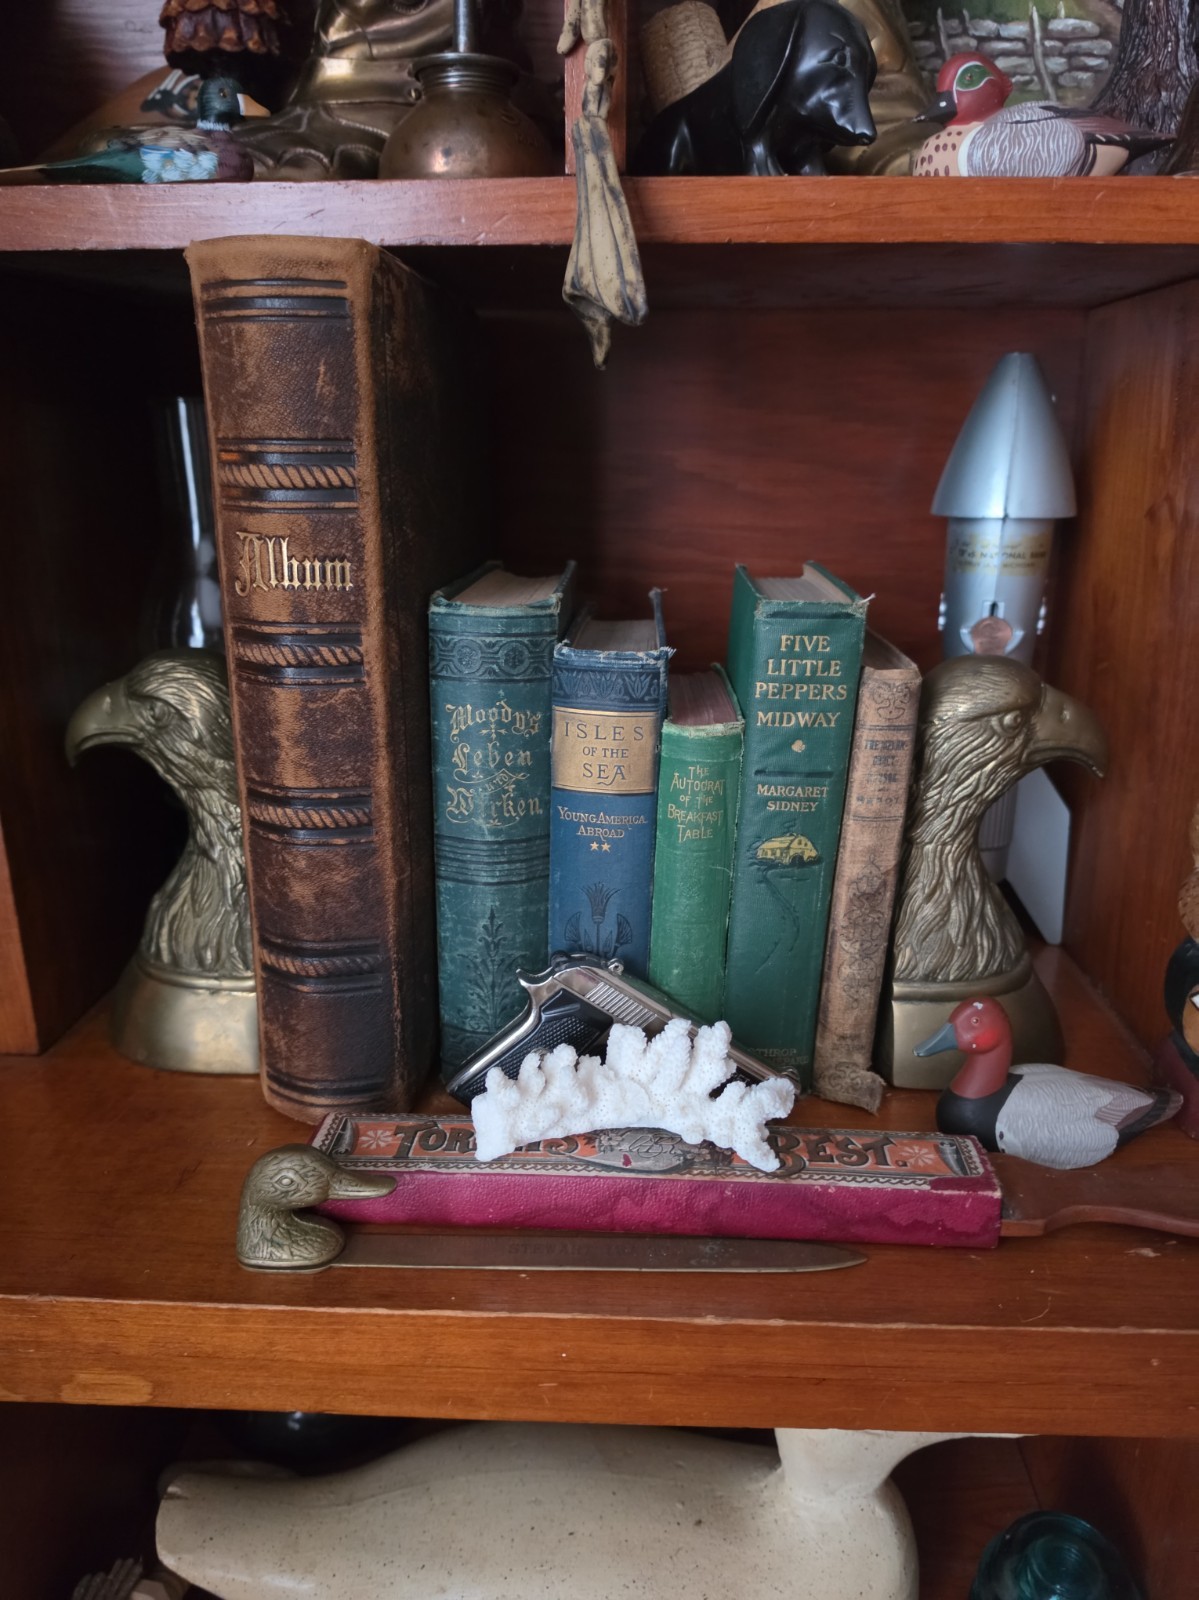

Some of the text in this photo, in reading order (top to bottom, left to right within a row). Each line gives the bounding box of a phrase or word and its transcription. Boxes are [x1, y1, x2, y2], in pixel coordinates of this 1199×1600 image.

[235, 531, 353, 596] Album
[780, 635, 831, 652] FIVE
[767, 658, 842, 677] LITTLE
[755, 682, 847, 700] PEPPERS
[756, 711, 840, 728] MIDWAY
[564, 721, 645, 741] ISLES
[452, 740, 533, 775] Leben
[582, 746, 629, 758] OF THE
[582, 762, 627, 785] SEA
[688, 766, 710, 778] THE
[670, 773, 725, 796] AUTOCRAT
[756, 784, 829, 798] MARGARET
[668, 803, 724, 825] BREAKFAST
[766, 800, 819, 812] SIDNEY
[596, 812, 648, 824] AMERICA
[576, 824, 625, 841] ABROAD
[677, 825, 713, 843] TABLE
[767, 1133, 909, 1178] BEST.
